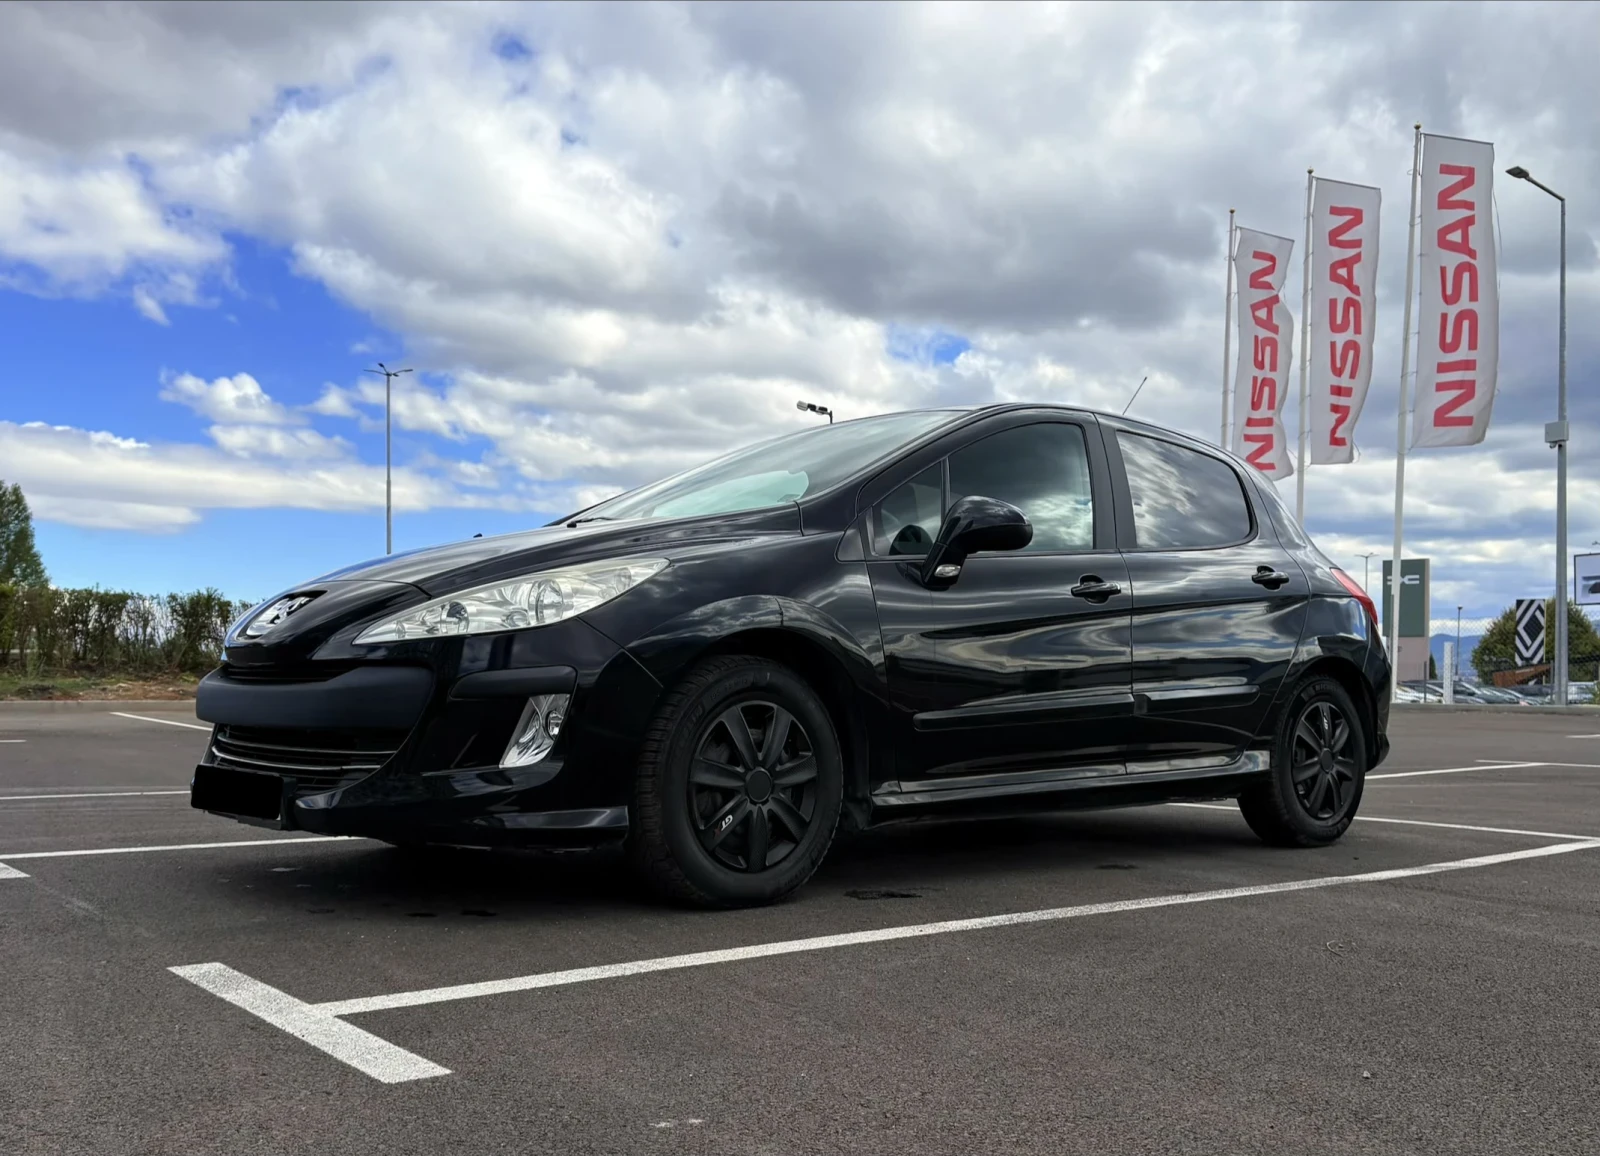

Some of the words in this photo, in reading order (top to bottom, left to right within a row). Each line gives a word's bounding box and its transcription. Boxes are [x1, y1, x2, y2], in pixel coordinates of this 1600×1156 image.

[1243, 250, 1280, 471] NISSAN
[1328, 205, 1364, 447] NISSAN
[1433, 163, 1479, 428] NISSAN
